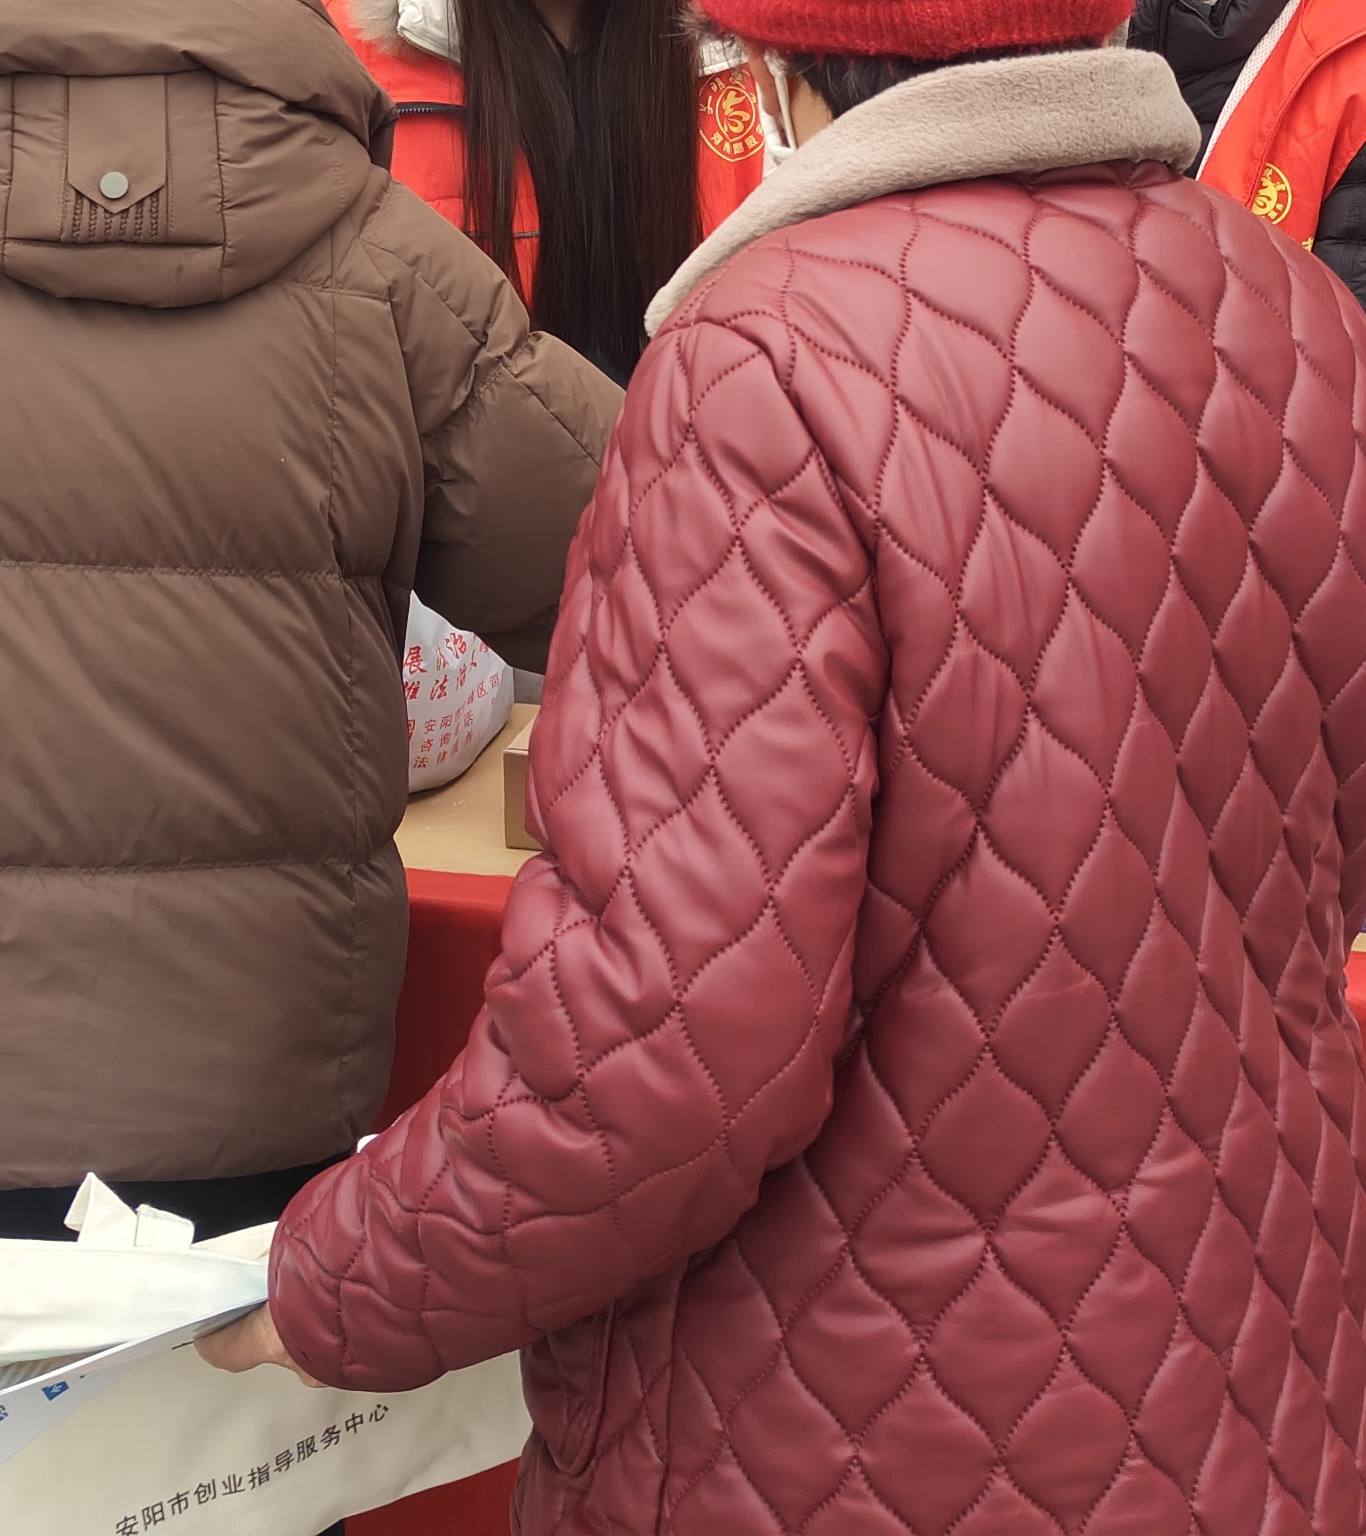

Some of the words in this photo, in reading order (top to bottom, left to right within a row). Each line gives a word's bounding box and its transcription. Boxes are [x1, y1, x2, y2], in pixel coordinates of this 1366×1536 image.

[114, 1403, 390, 1536] 安阳市创业指导服务中心
